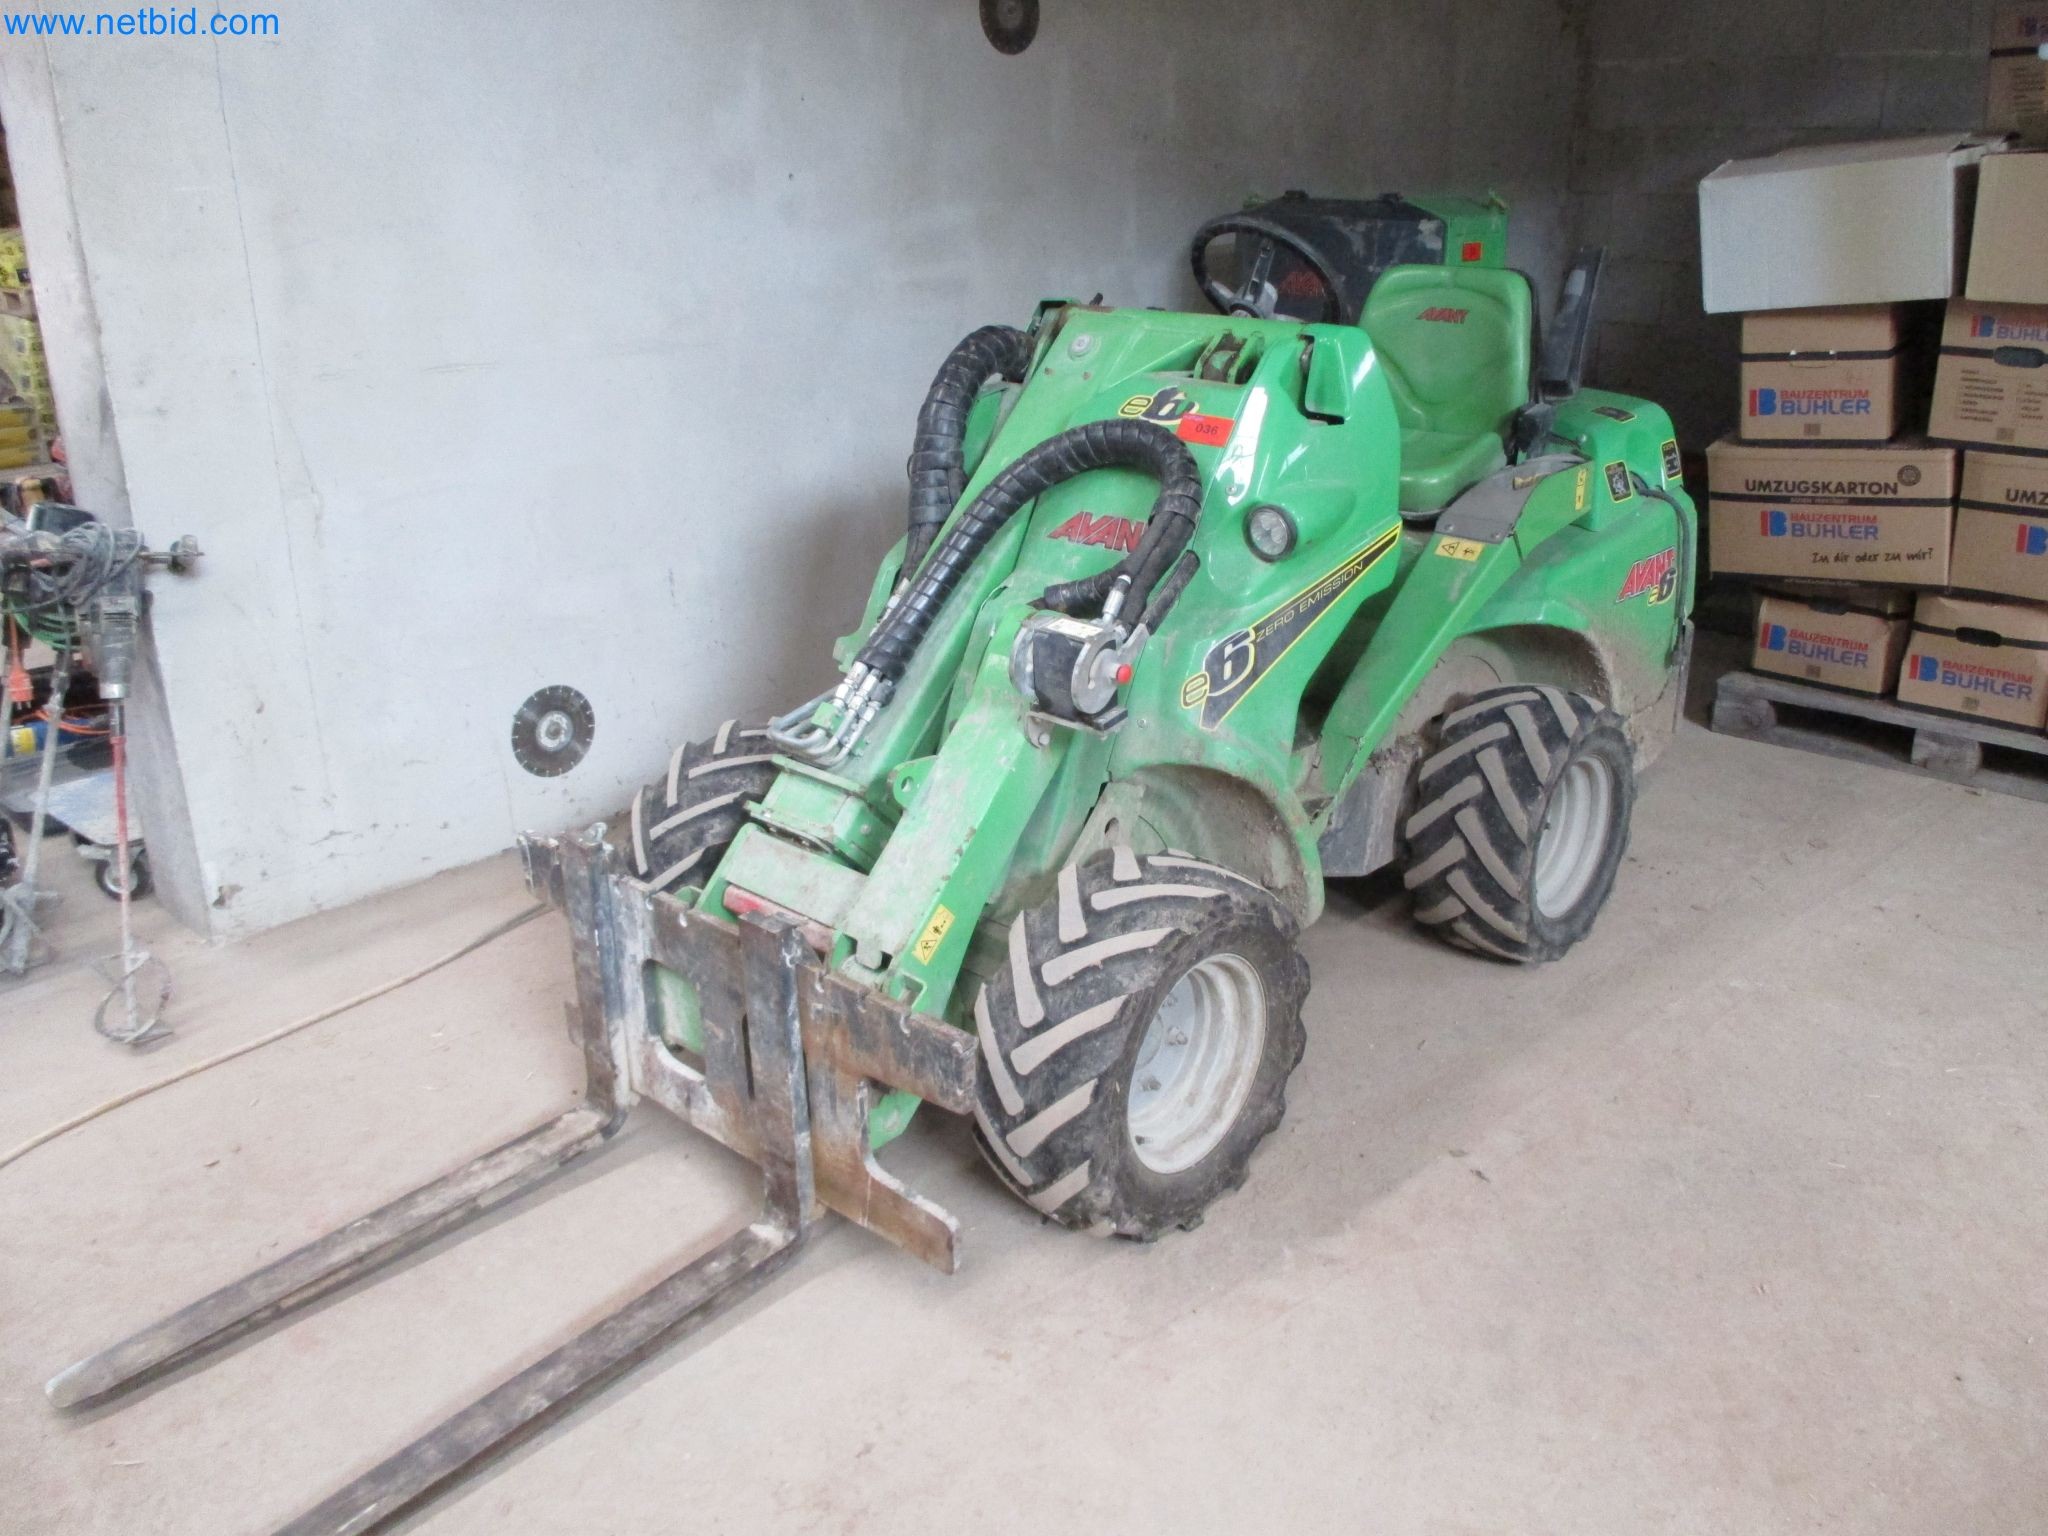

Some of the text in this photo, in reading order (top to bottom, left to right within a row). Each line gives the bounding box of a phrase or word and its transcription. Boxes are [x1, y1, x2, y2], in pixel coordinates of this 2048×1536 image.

[1780, 389, 1869, 400] BAUZENTRUM
[1195, 422, 1219, 435] 036
[1744, 478, 1899, 496] UMZUGSKARTON
[1790, 512, 1878, 525] BAUZENTRUM
[1256, 560, 1363, 643] ZERO EMISSION
[1788, 629, 1869, 651] BAUZENTRUM
[1942, 660, 2033, 683] BAUZENTRUM
